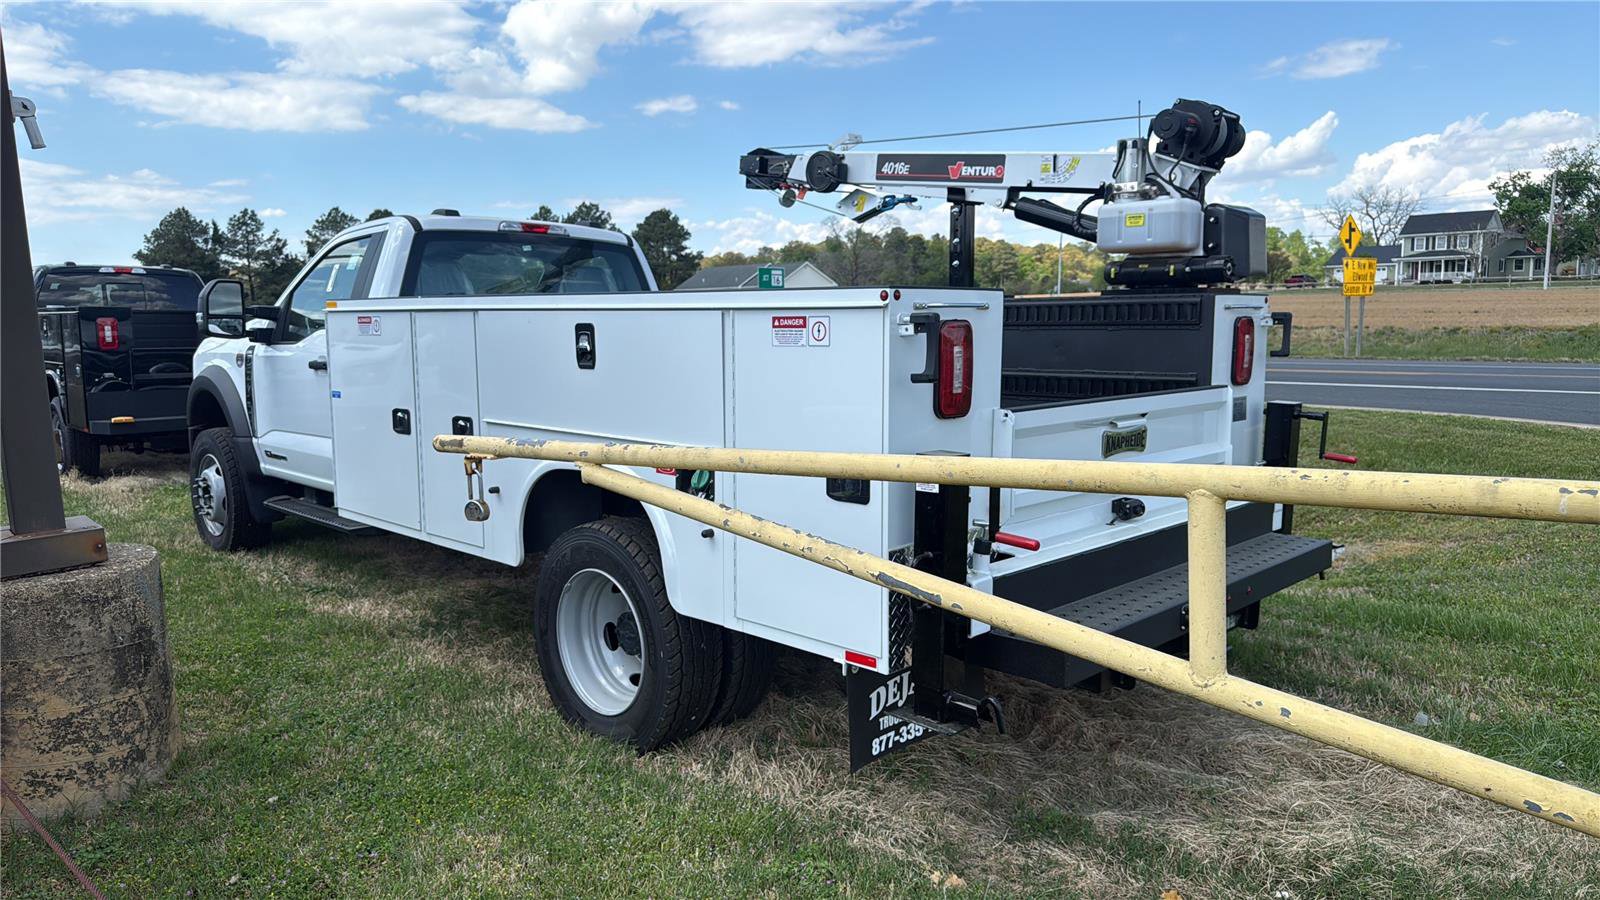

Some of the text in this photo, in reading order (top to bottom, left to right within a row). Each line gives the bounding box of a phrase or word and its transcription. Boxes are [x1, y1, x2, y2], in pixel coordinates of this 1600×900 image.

[881, 162, 910, 175] 4016E
[948, 161, 1004, 179] VENTURO
[773, 276, 782, 285] 16
[1105, 430, 1145, 454] KNAPHEIDE
